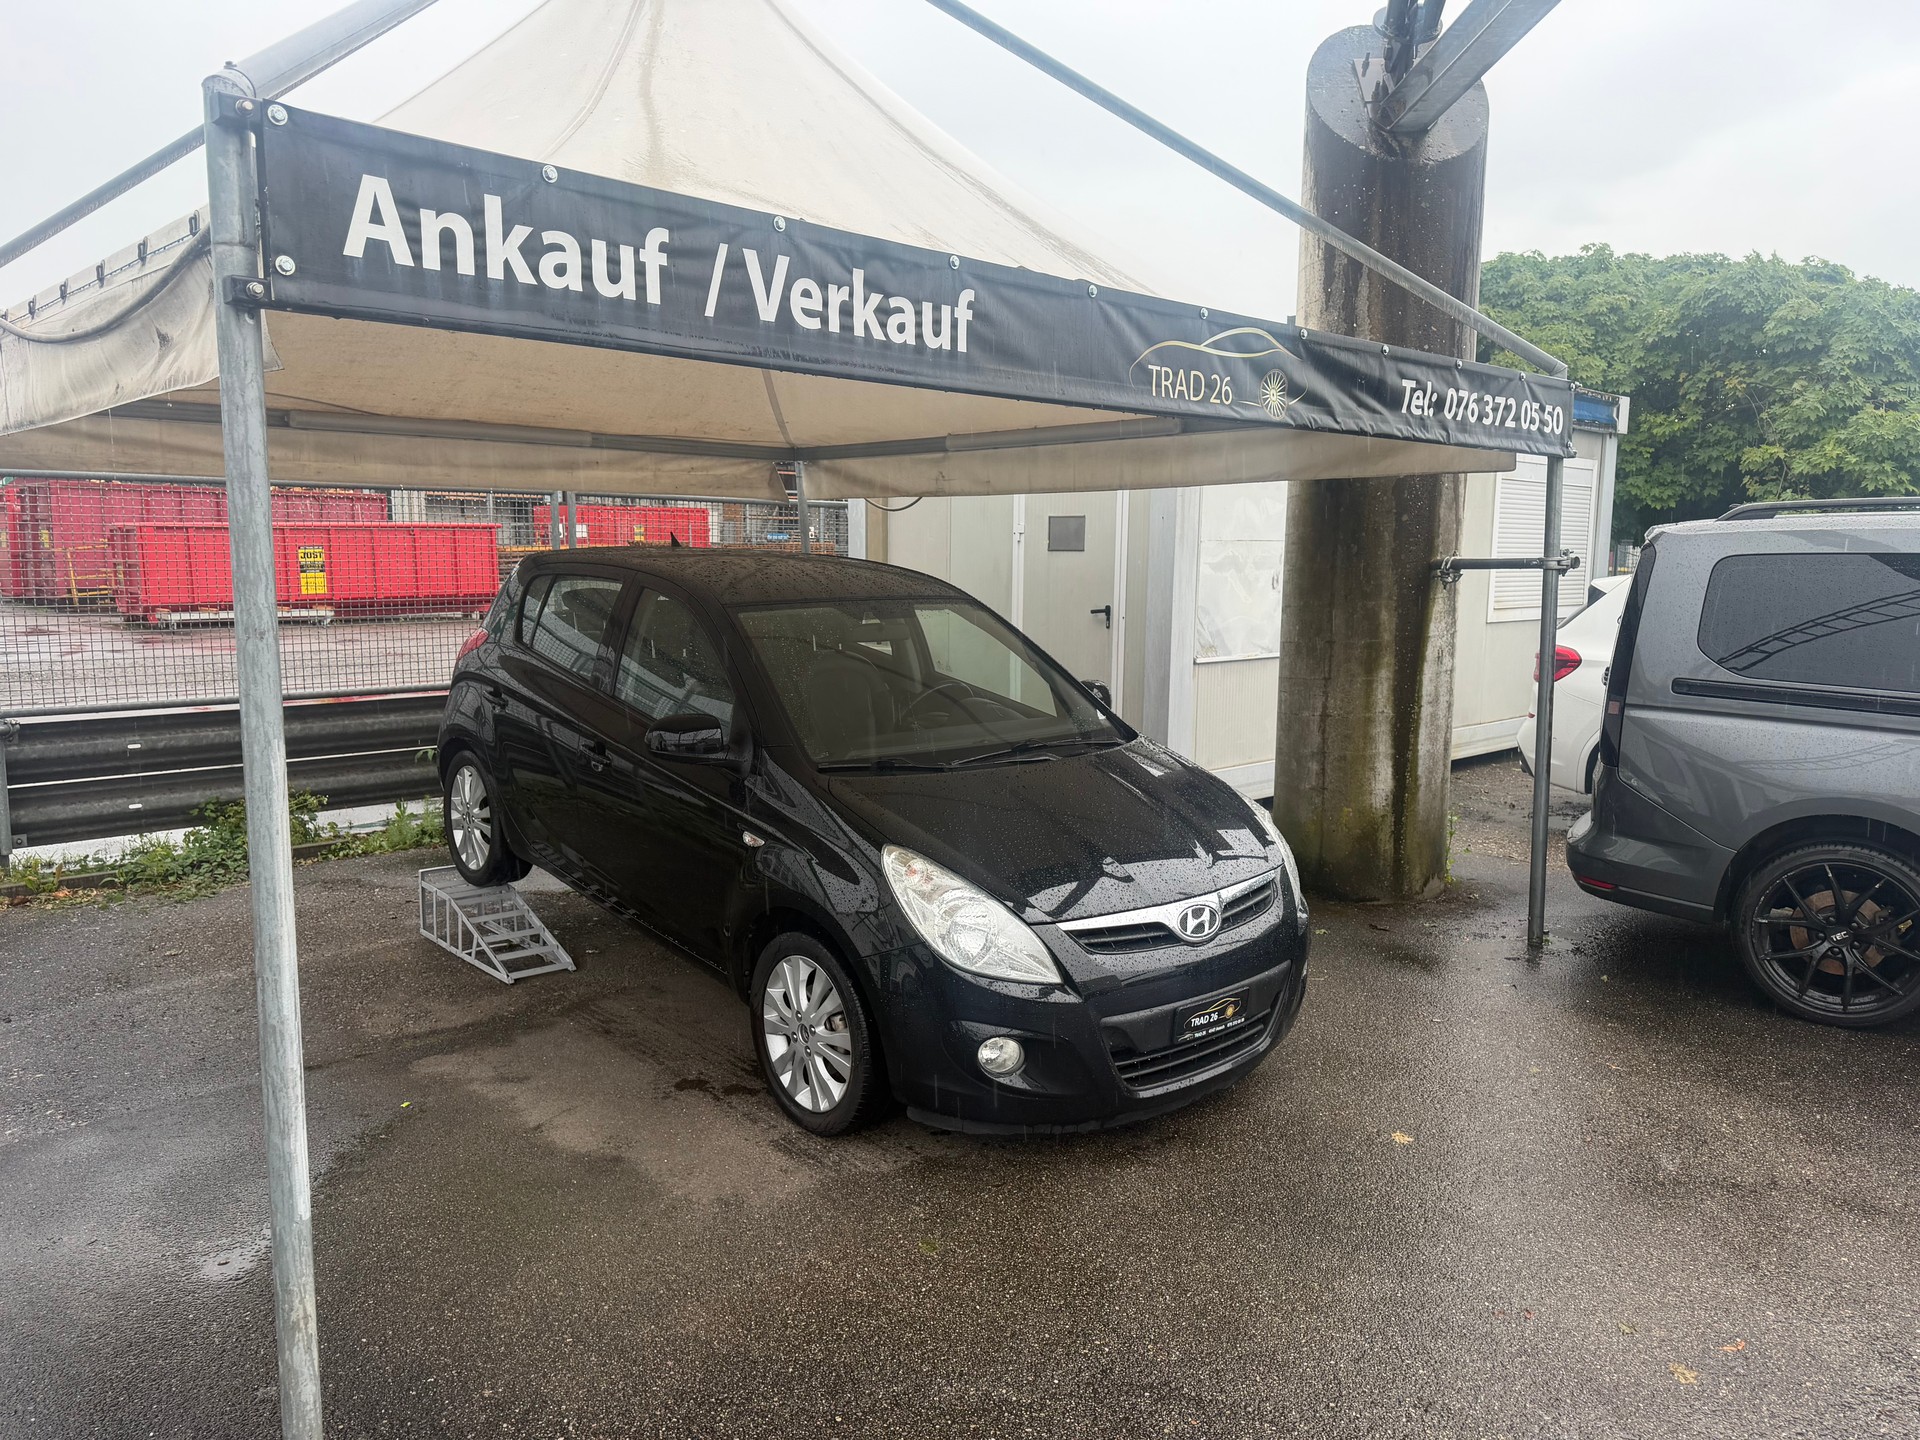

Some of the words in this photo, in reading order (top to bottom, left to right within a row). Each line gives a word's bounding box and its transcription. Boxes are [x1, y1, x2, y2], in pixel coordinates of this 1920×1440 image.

[343, 174, 669, 305] Ankauf
[742, 248, 975, 353] Verkauf
[1148, 365, 1205, 401] TRAD
[1210, 374, 1233, 405] 26
[1401, 379, 1438, 417] Tel:
[1443, 388, 1479, 423] 076
[1482, 395, 1517, 428] 372
[1520, 400, 1540, 431] 05
[1543, 405, 1564, 435] 50
[1191, 1015, 1210, 1027] TRAD
[1210, 1012, 1218, 1022] 26
